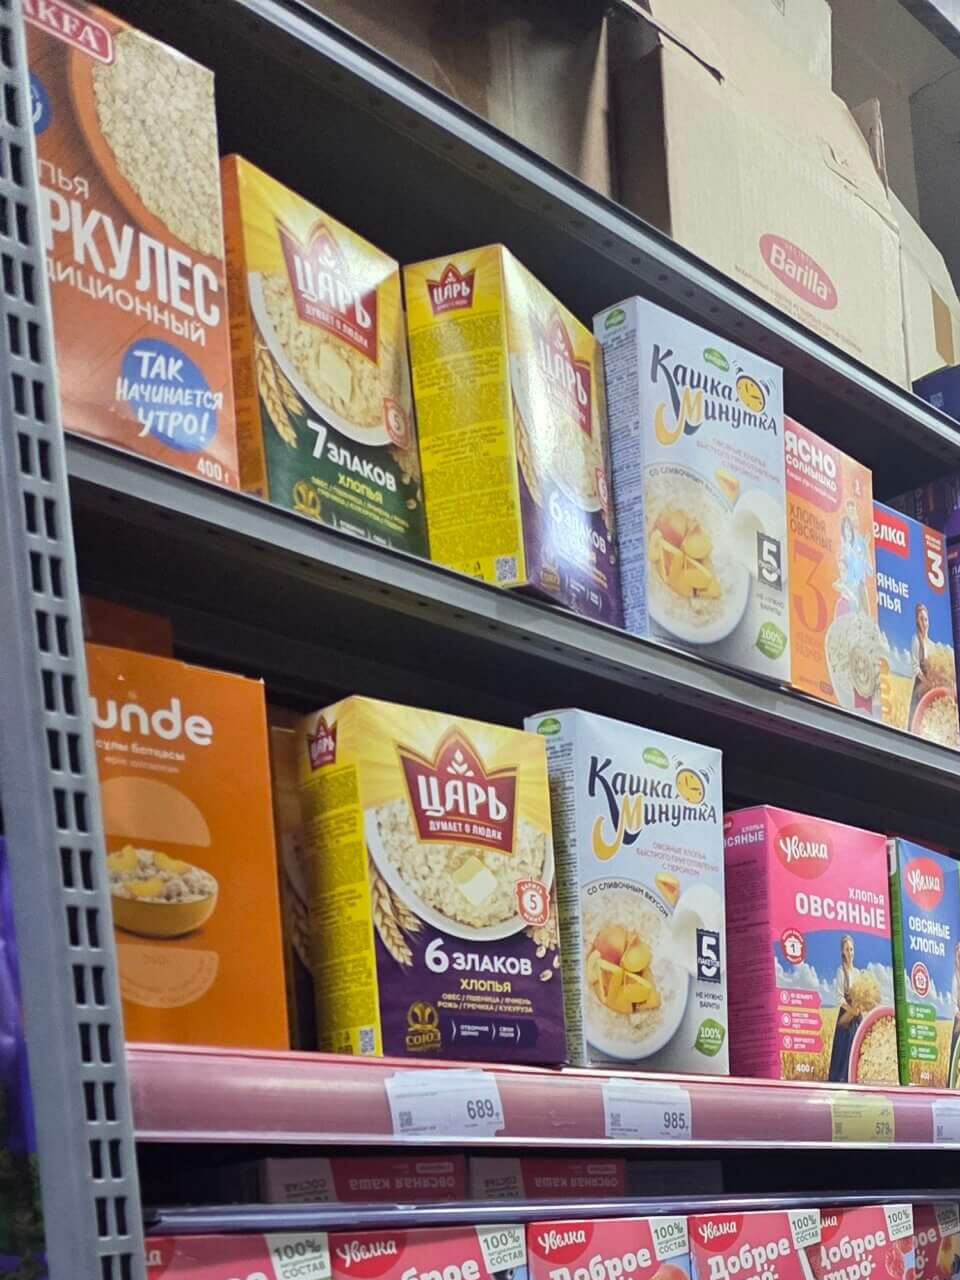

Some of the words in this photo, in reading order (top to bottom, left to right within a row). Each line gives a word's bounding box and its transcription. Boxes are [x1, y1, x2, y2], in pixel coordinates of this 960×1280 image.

[39, 185, 221, 327] РКУЛЕС
[768, 252, 832, 300] Barilla
[293, 254, 373, 330] ЦАРЬ
[433, 281, 472, 302] ЦАРЬ
[133, 350, 184, 382] ТАК
[115, 377, 224, 411] НАЧИНАЕТСЯ
[650, 344, 734, 423] Кашка
[137, 407, 212, 443] УТРО!
[307, 420, 327, 459] 7
[327, 443, 398, 493] ЗЛАКОВ
[785, 430, 837, 475] ЯСНО
[197, 457, 222, 482] 400
[786, 455, 838, 492] СОЛНЫШКО
[338, 473, 384, 506] ХЛОПЬЯ
[789, 505, 826, 532] ХЛОПЬЯ
[790, 523, 833, 553] ОВСЯНЫЕ
[762, 543, 779, 582] 5
[926, 552, 944, 588] 3
[793, 545, 828, 632] 3
[418, 773, 508, 822] ЦАРЬ
[588, 756, 674, 836] Кашка
[429, 819, 463, 835] ДУМАЕТ
[464, 824, 471, 836] О
[472, 825, 503, 841] ЛЮДЯХ
[594, 792, 718, 862] Минутка
[779, 836, 829, 864] Увелка
[907, 867, 941, 892] Увелка
[528, 895, 538, 913] 5
[587, 887, 598, 897] СО
[598, 880, 645, 895] СЛИВОЧНЫМ
[644, 891, 669, 919] ВКУСОМ
[848, 886, 885, 906] ХЛОПЬЯ
[794, 891, 886, 931] ОВСЯНЫЕ
[908, 914, 950, 940] ОВСЯНЫЕ
[425, 938, 449, 974] 6
[452, 953, 533, 976] ЗЛАКОВ
[701, 935, 718, 978] 5
[909, 934, 945, 957] ХЛОПЬЯ
[460, 978, 512, 993] ХЛОПЬЯ
[700, 1026, 721, 1040] 100%
[653, 1217, 685, 1240] 100%
[791, 1215, 818, 1231] 100%
[887, 1208, 910, 1224] 100%
[890, 1223, 913, 1236] СОСТАВ
[482, 1229, 521, 1250] 100%
[538, 1229, 587, 1253] Увелка
[657, 1236, 689, 1253] СОСТАВ
[700, 1221, 738, 1244] Увелка
[796, 1229, 821, 1244] СОСТАВ
[274, 1241, 322, 1263] 100%
[336, 1239, 398, 1268] Увелка
[489, 1251, 525, 1267] СОСТАВ
[282, 1260, 326, 1280] СОСТАВ
